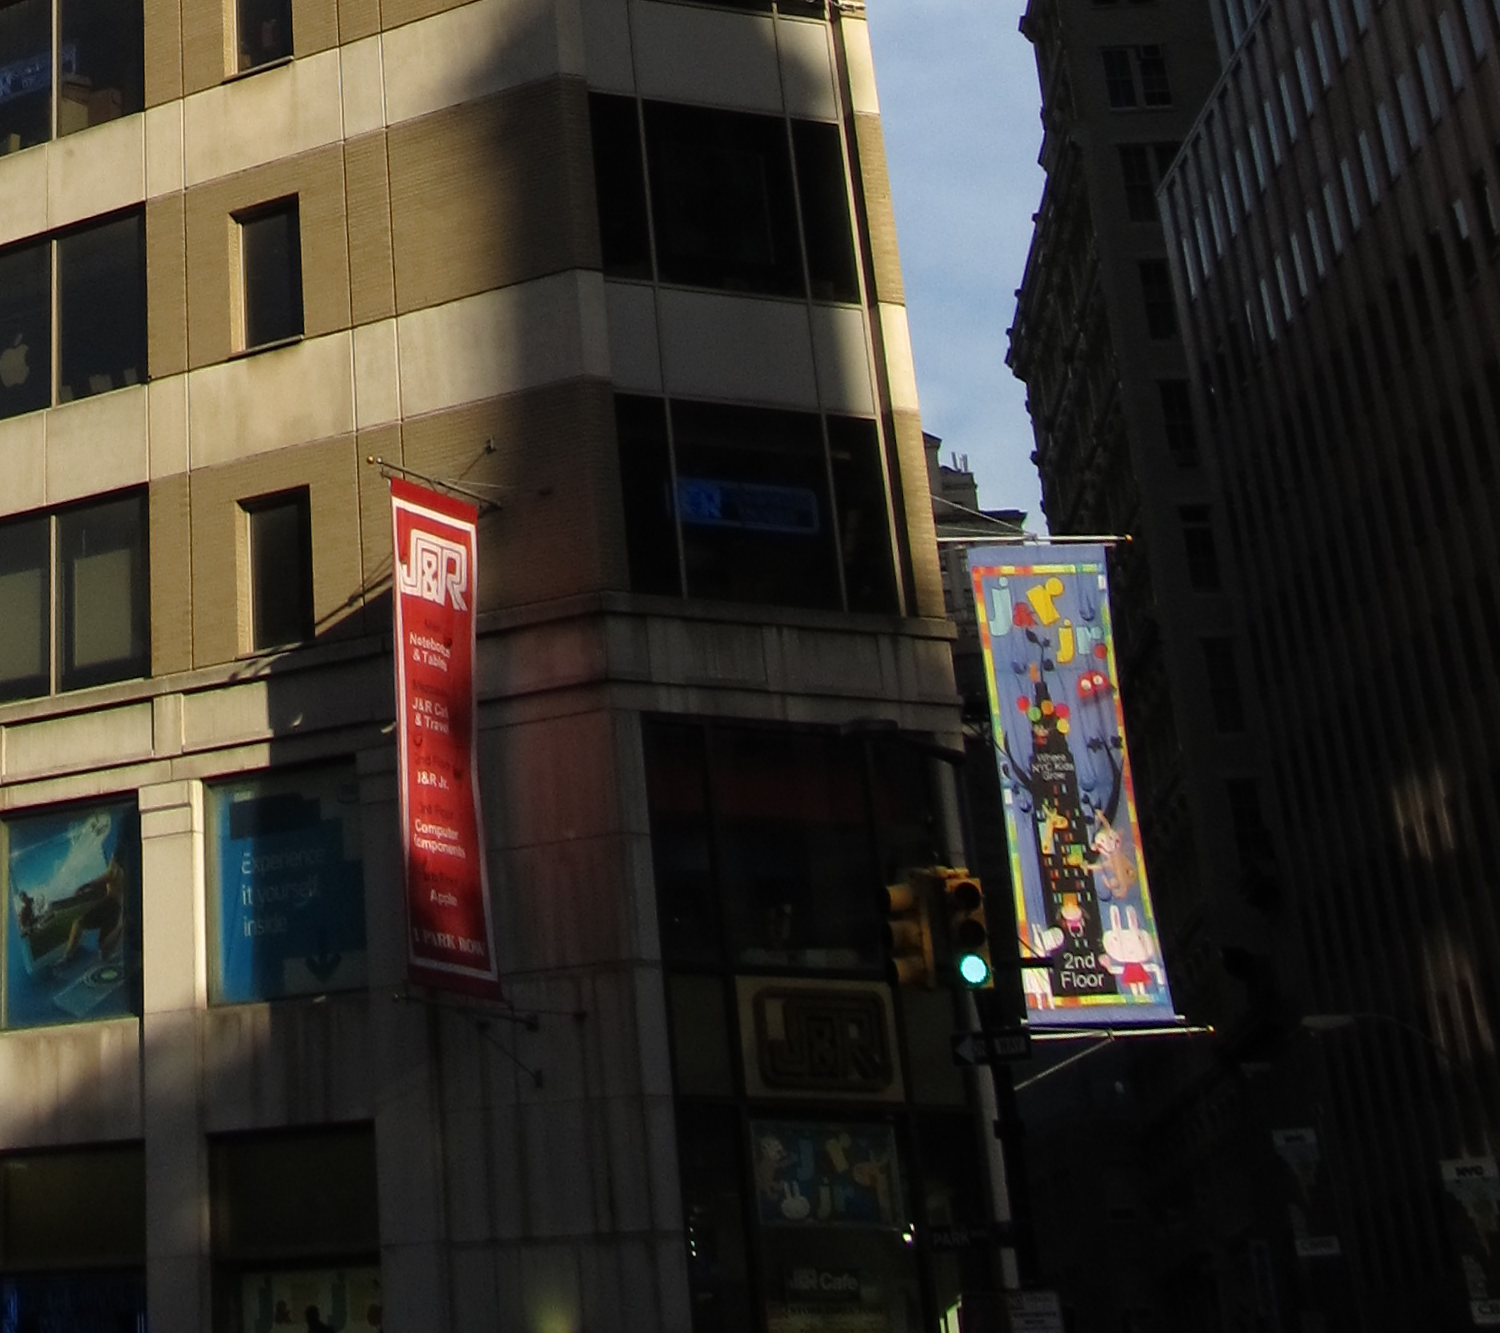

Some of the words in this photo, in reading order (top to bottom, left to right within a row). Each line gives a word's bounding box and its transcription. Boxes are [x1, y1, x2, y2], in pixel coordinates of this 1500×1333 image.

[400, 528, 468, 612] J&R
[412, 648, 421, 663] &
[412, 696, 433, 714] J&R
[414, 714, 423, 727] &
[416, 769, 438, 788] J&R
[414, 818, 459, 841] Computer
[413, 833, 467, 859] Components
[242, 850, 325, 874] Experience
[242, 884, 254, 906] it
[429, 888, 458, 908] Apple
[422, 929, 456, 951] PARK
[458, 934, 485, 957] ROW
[1063, 951, 1097, 970] 2nd
[1060, 969, 1106, 991] Floor
[819, 1271, 858, 1291] Cafe
